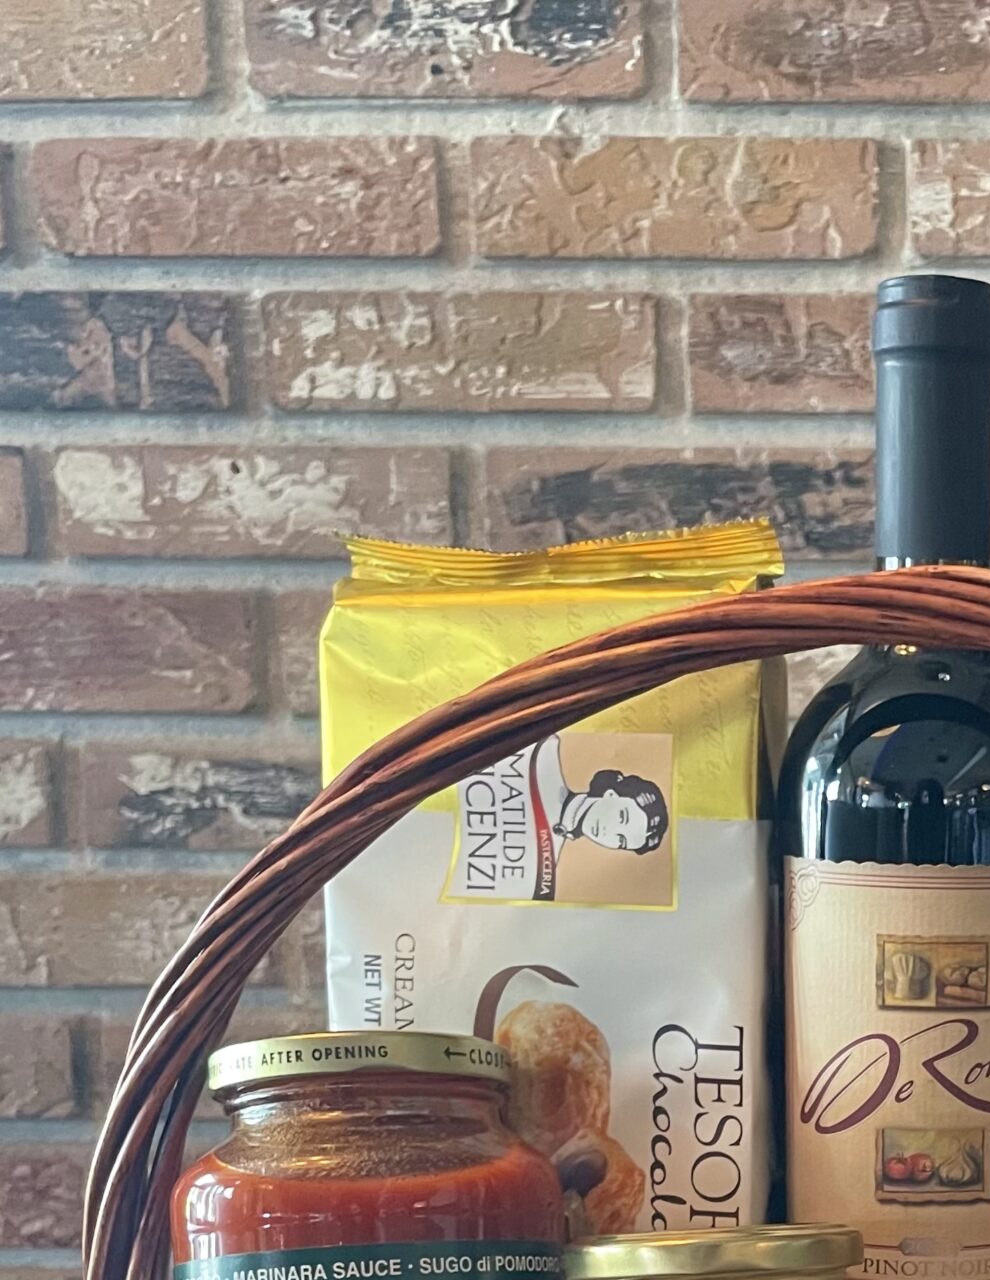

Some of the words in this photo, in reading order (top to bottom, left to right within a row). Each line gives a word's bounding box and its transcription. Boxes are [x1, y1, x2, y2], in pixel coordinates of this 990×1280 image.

[465, 764, 498, 891] ICENZI
[500, 753, 526, 879] MATILDE
[539, 828, 553, 895] PASTICCERIA
[363, 954, 382, 991] NET
[363, 997, 381, 1027] WT
[261, 1050, 303, 1066] AFTER
[311, 1045, 389, 1061] OPENING
[333, 1257, 402, 1279] SAUCE
[419, 1255, 473, 1274] SUGO
[477, 1257, 491, 1273] di
[863, 1258, 931, 1277] PINOT
